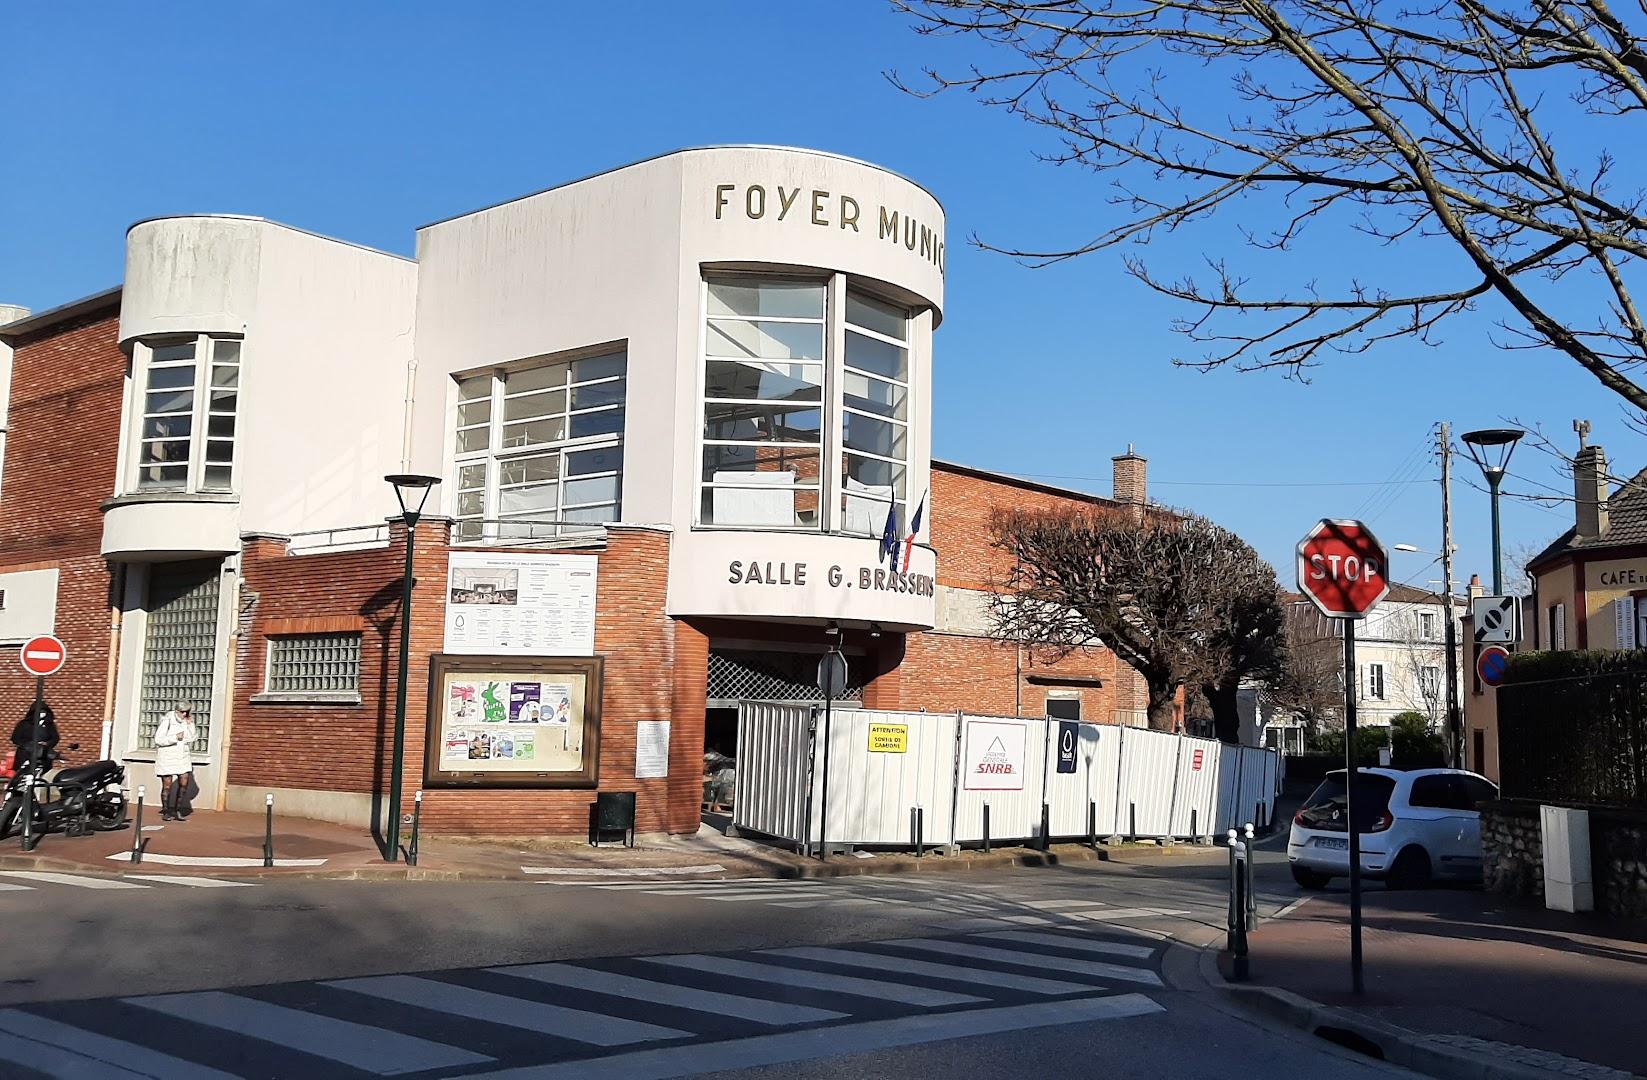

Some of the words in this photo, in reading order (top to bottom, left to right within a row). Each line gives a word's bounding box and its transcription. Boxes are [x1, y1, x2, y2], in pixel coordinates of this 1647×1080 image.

[715, 184, 860, 233] FOYER
[728, 560, 807, 586] SALLE
[1309, 553, 1380, 583] STOP
[1600, 569, 1636, 585] CAFE
[977, 763, 1012, 774] SNRB
